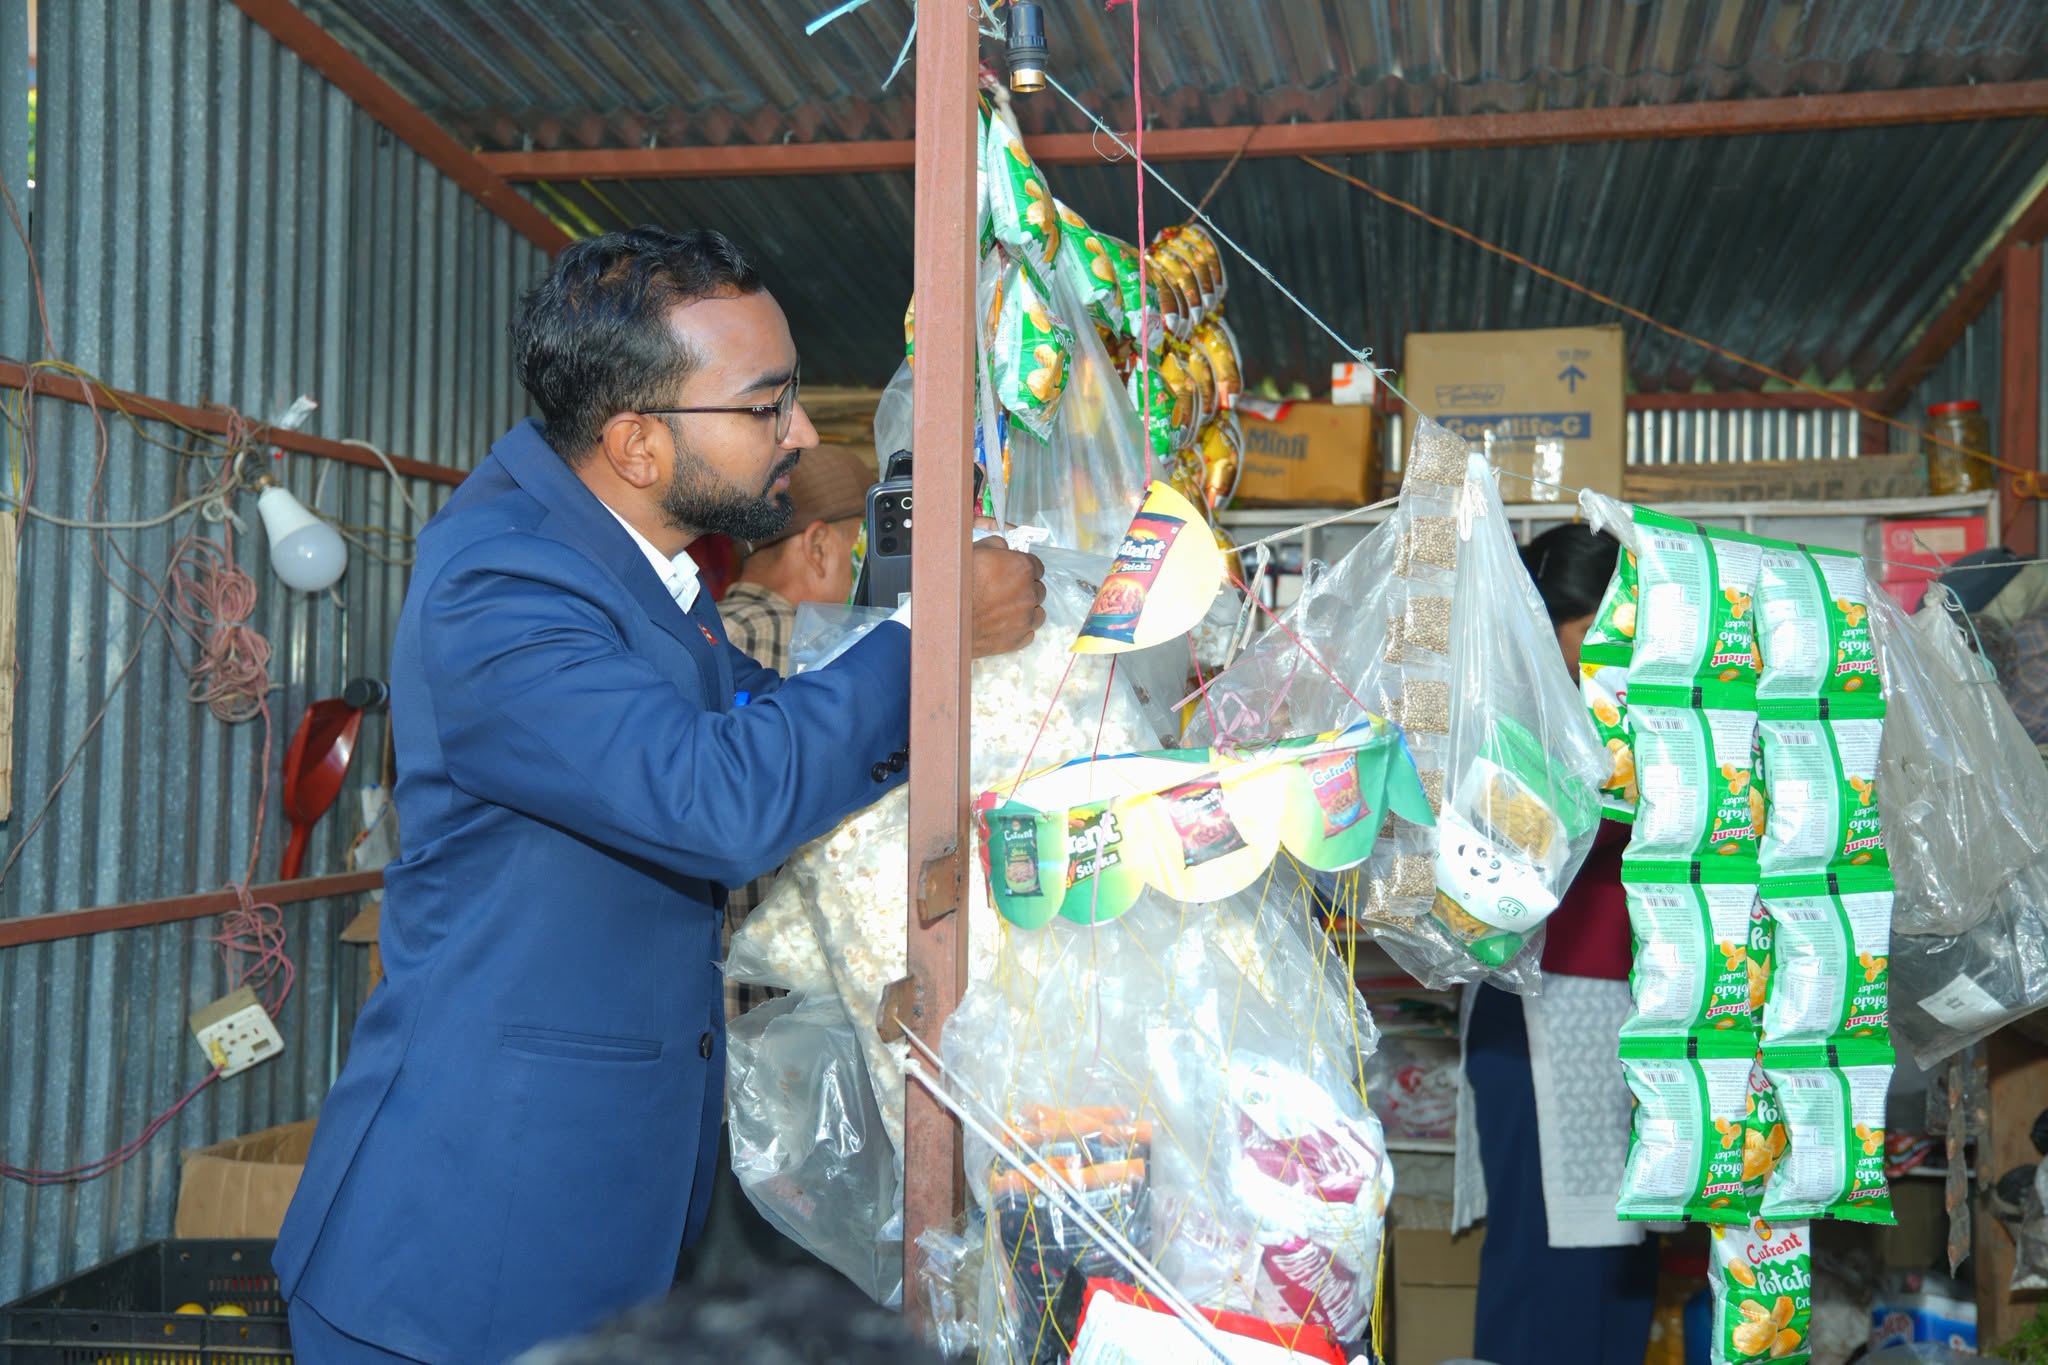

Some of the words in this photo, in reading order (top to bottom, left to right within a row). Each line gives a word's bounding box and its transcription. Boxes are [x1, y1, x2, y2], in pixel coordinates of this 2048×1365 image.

[1719, 631, 1752, 648] otato
[1717, 808, 1752, 824] otato
[1849, 817, 1882, 834] otato
[1858, 1155, 1885, 1168] racker
[1710, 1162, 1743, 1178] otato
[1756, 1264, 1811, 1296] Potato
